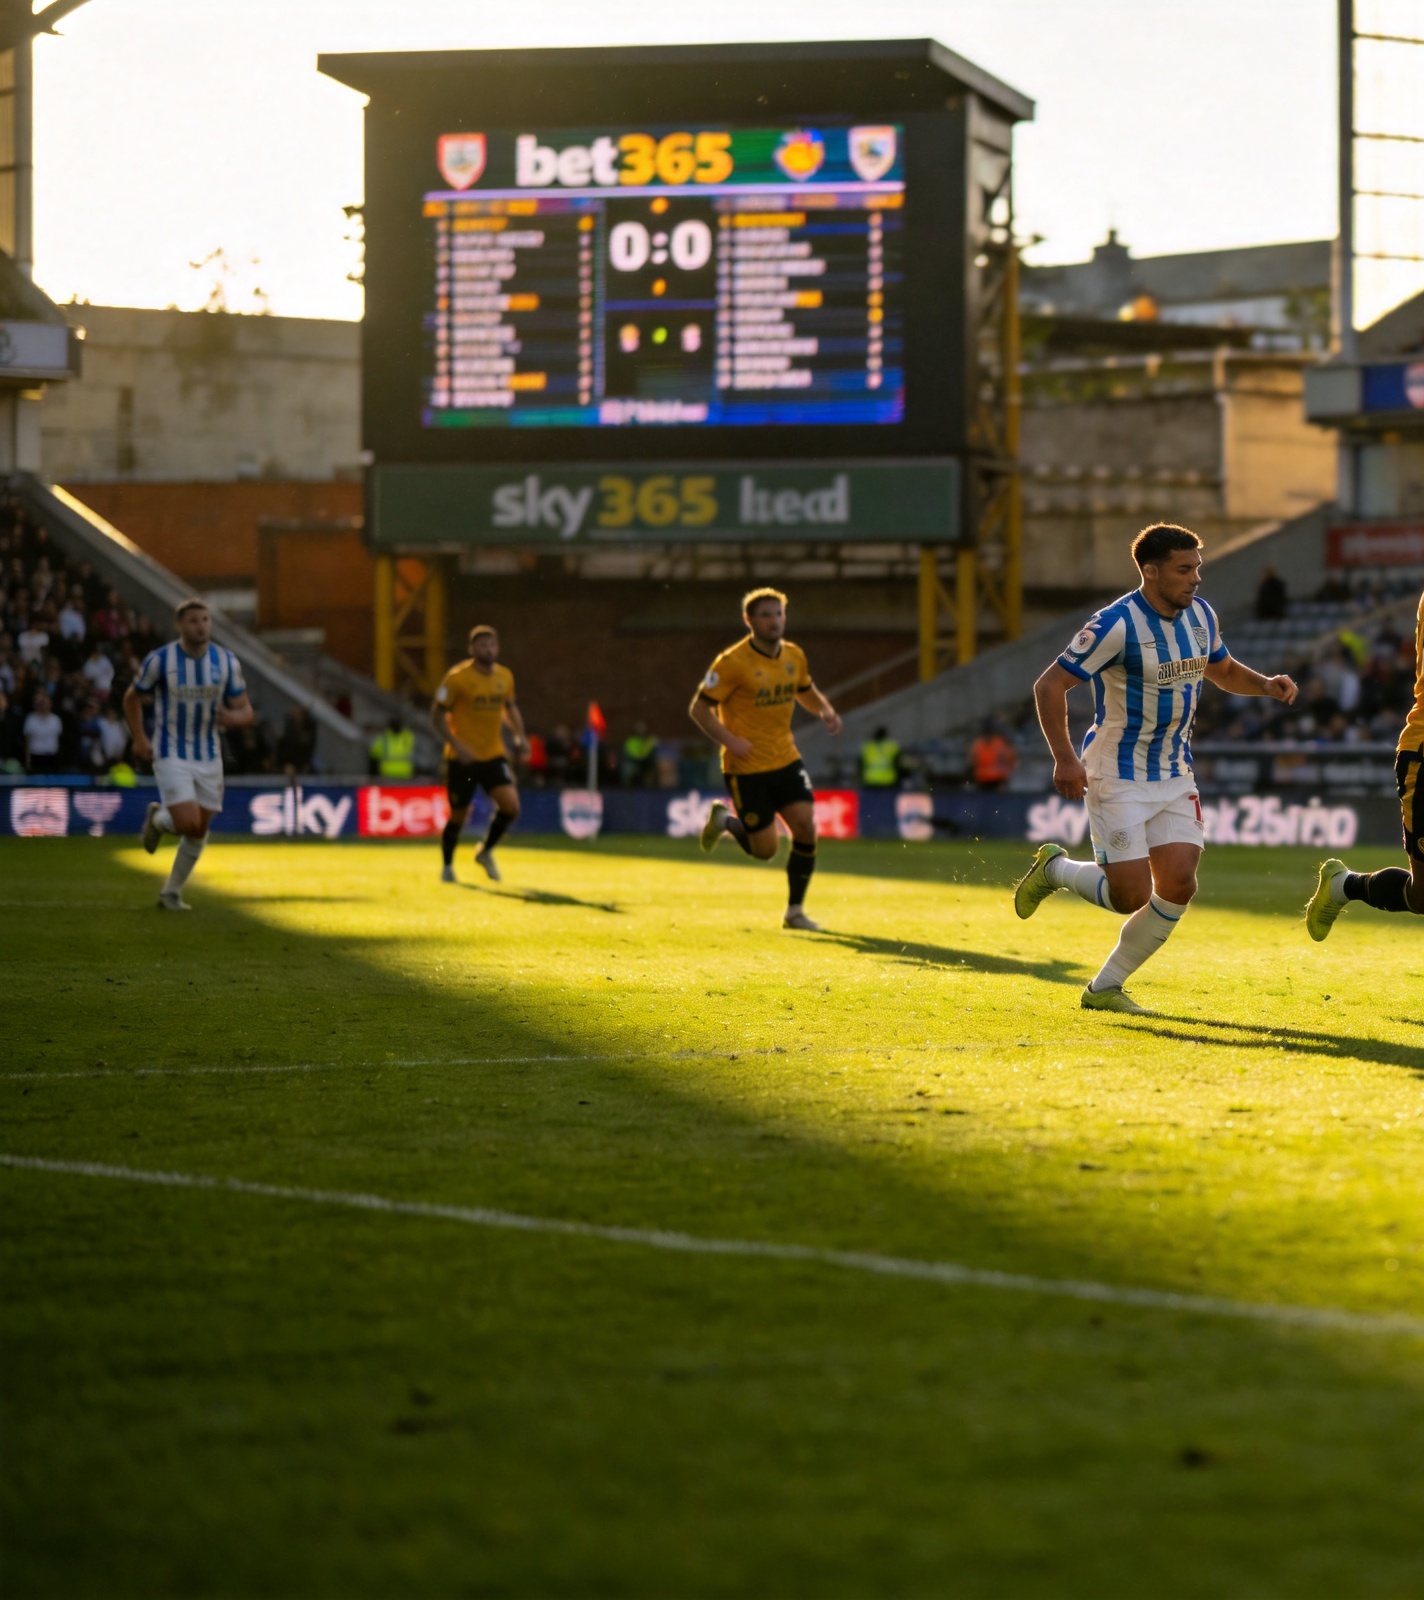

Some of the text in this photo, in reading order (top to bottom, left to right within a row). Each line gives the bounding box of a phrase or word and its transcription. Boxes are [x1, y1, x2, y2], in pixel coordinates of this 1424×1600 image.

[515, 133, 733, 187] bet365
[609, 220, 713, 271] 0:0
[250, 788, 352, 838] sky
